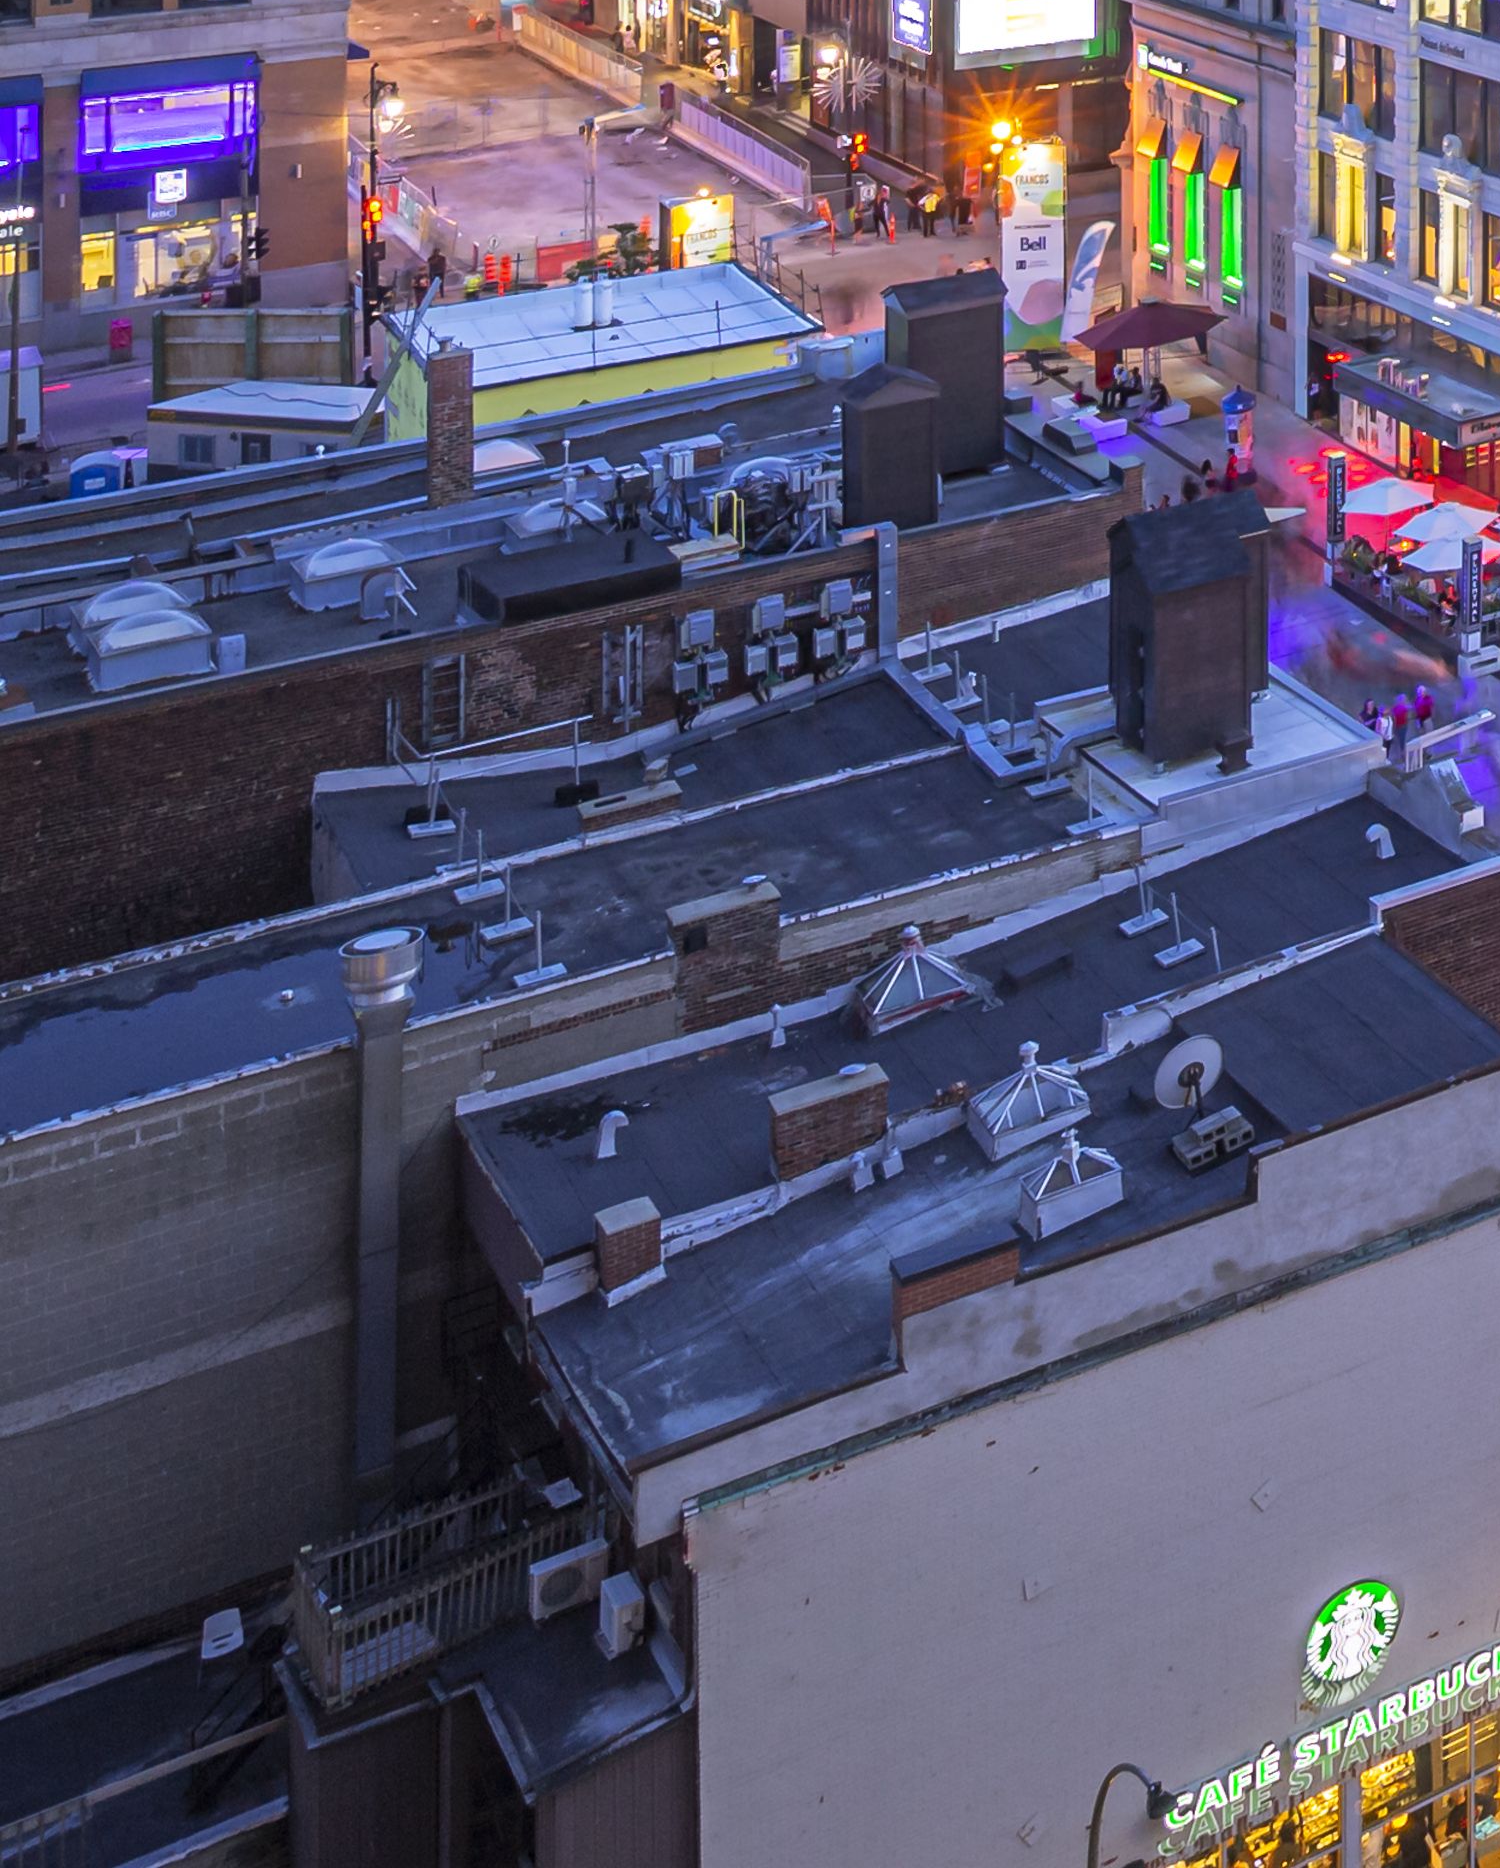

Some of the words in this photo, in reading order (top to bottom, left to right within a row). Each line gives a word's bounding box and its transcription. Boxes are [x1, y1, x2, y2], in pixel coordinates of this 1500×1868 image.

[1015, 173, 1049, 186] FRANCOS
[1020, 236, 1047, 251] Bell
[1163, 1743, 1281, 1831] CAFÉ
